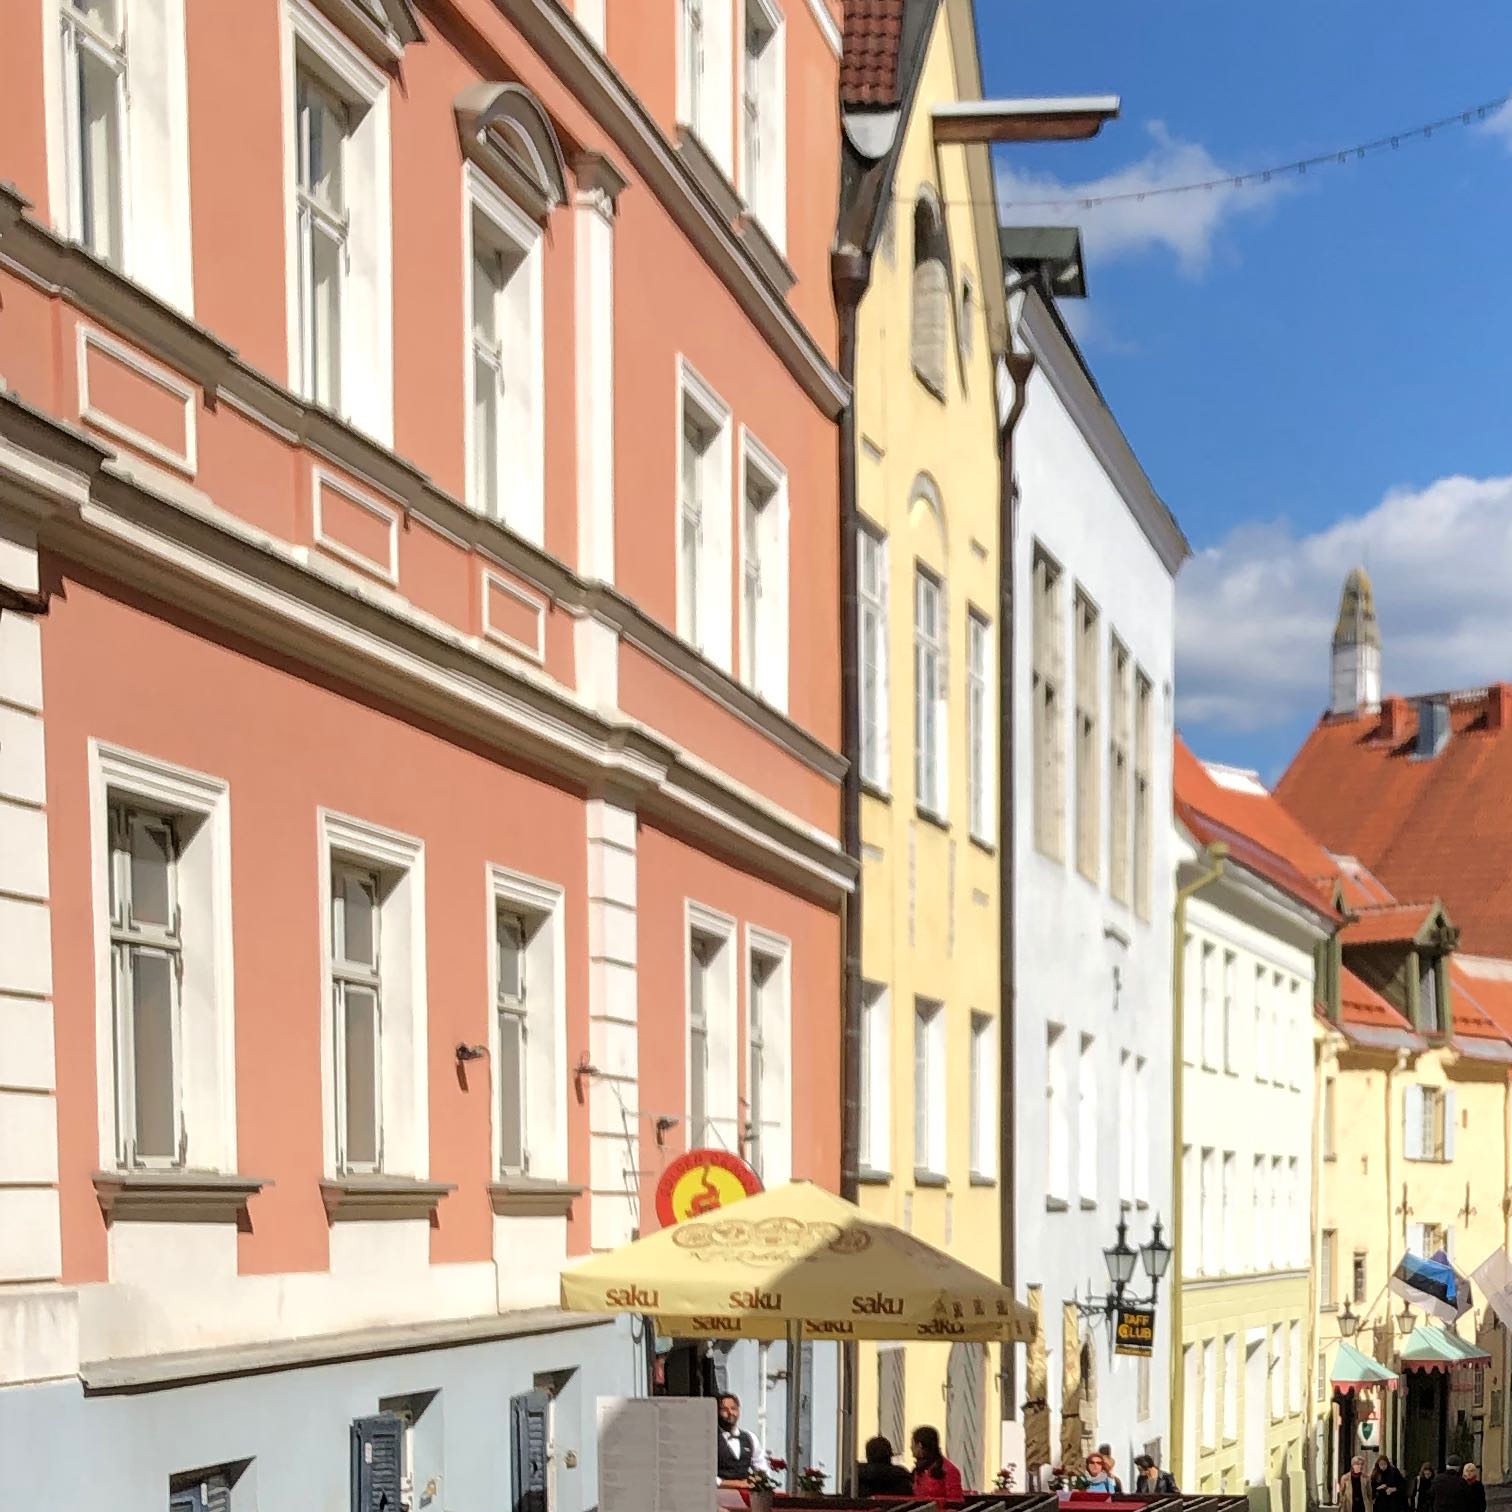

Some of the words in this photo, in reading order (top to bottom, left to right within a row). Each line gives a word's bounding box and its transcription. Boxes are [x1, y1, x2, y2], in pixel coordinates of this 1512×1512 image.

[605, 1284, 659, 1308] saku
[728, 1287, 782, 1311] saku
[852, 1290, 904, 1315] saku
[1118, 1323, 1152, 1340] CLUB
